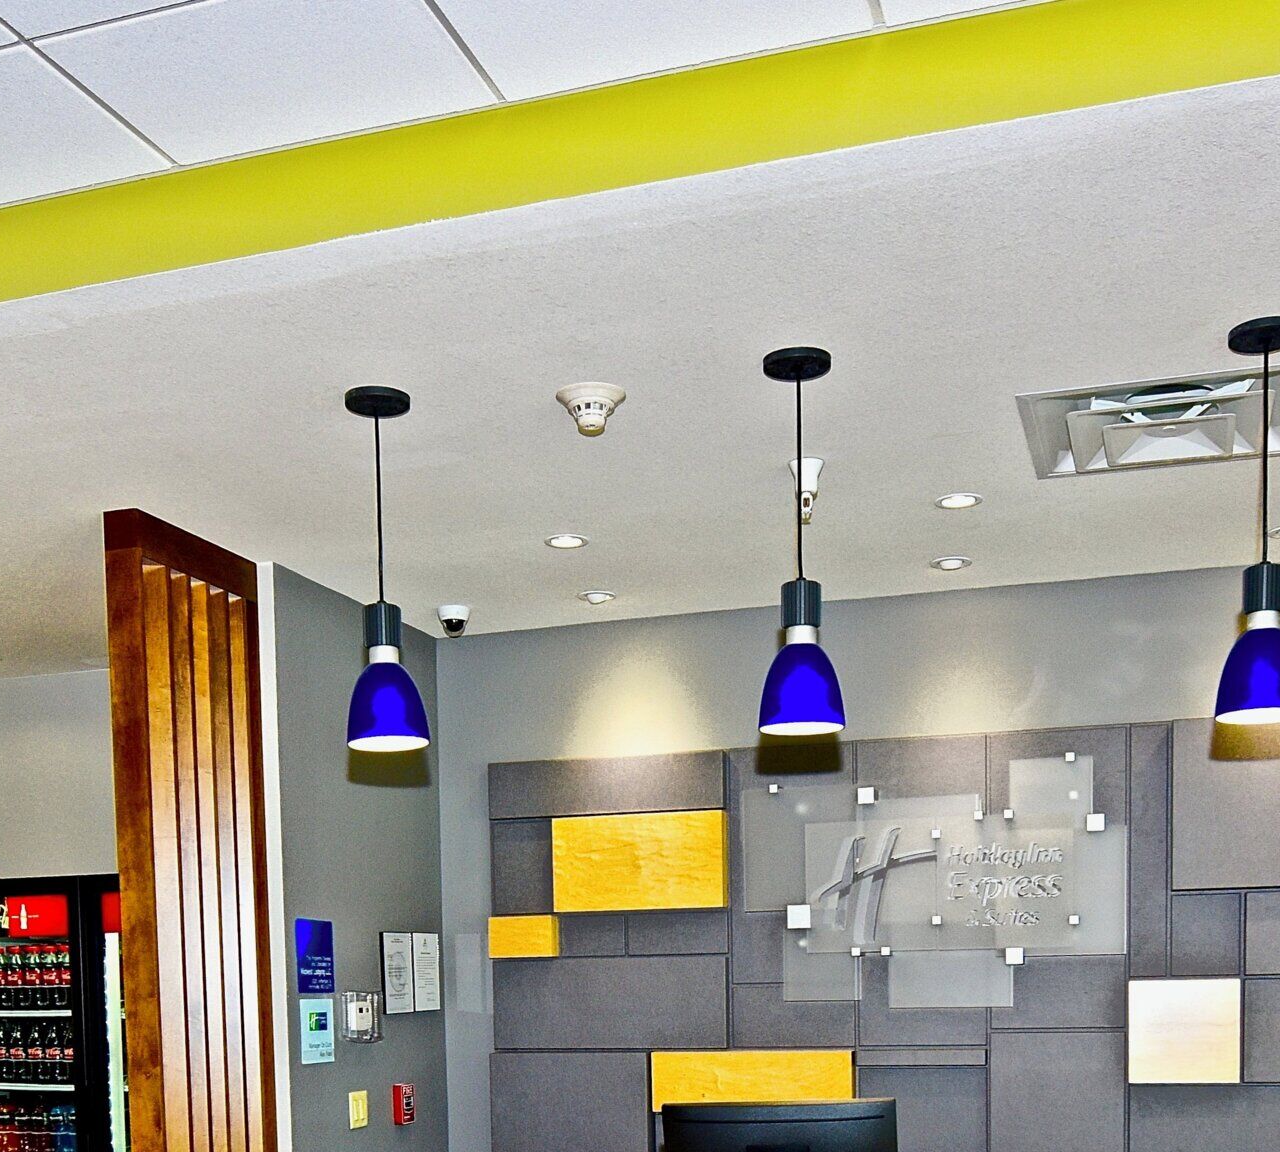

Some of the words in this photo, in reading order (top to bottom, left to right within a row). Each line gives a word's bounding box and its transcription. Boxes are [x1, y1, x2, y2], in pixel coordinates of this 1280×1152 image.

[947, 842, 1028, 869] Holiday
[1027, 842, 1064, 864] Inn
[947, 871, 1064, 907] Express
[981, 908, 1041, 927] Suites
